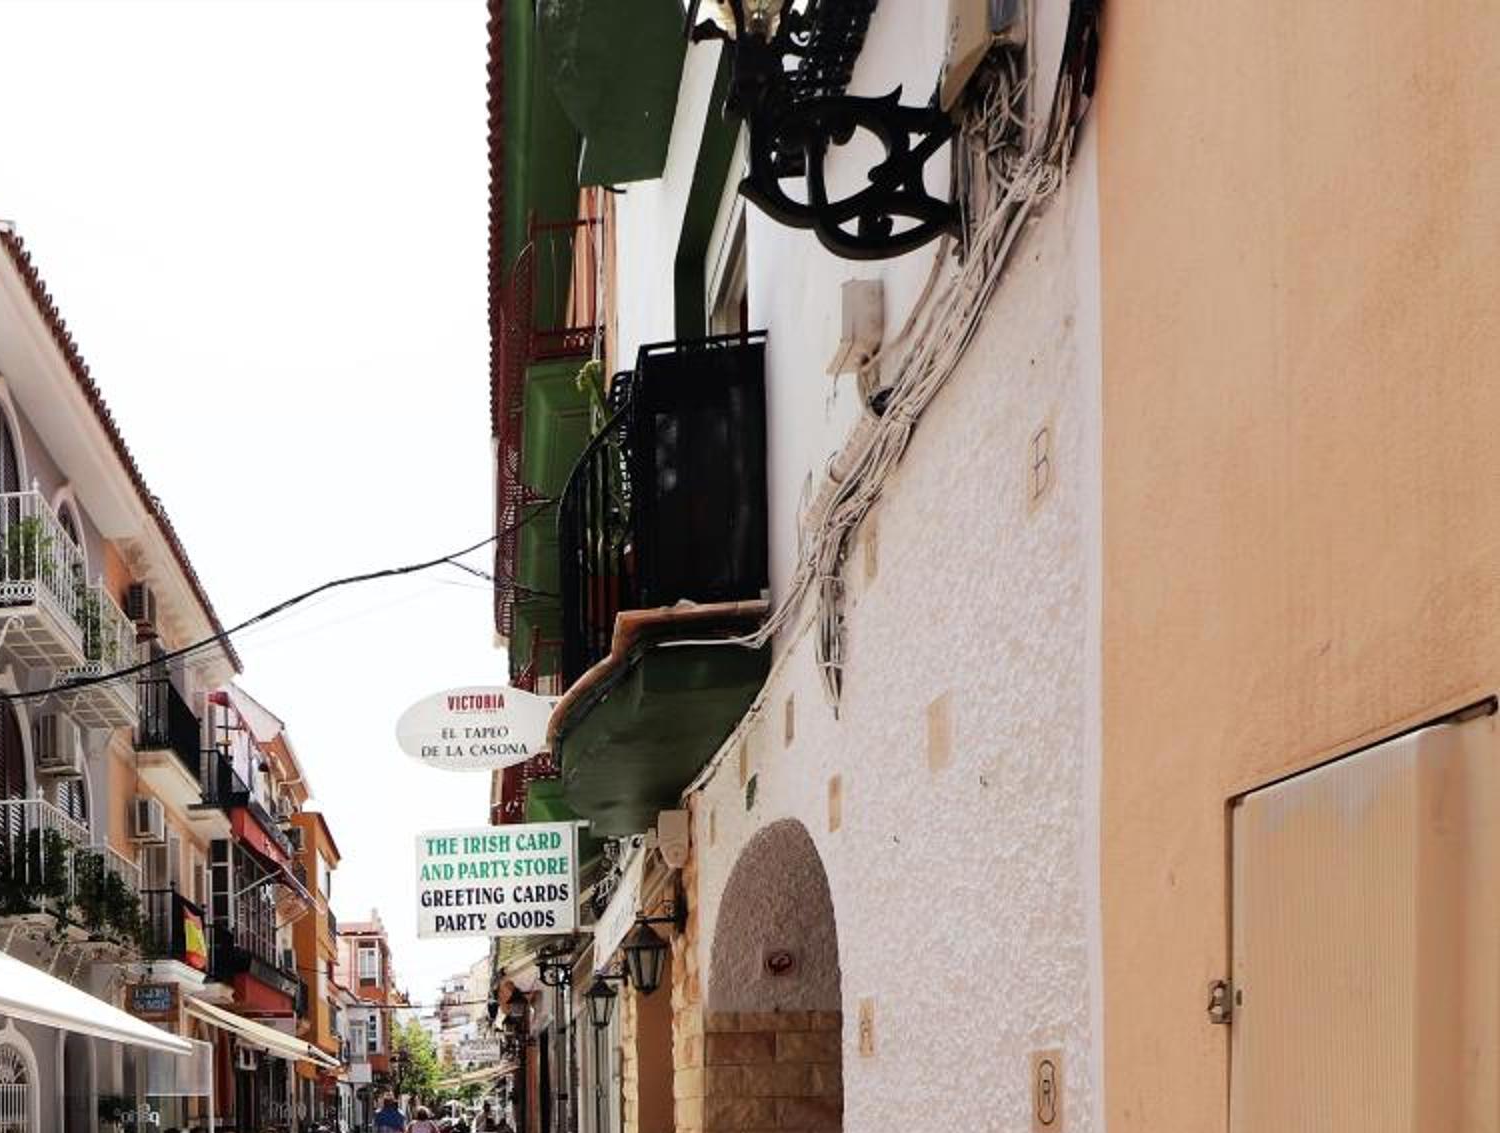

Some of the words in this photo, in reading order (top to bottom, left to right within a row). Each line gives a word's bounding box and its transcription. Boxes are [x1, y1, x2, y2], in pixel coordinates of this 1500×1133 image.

[448, 694, 505, 711] VICTORIA
[442, 728, 457, 739] EL
[422, 746, 439, 757] DE
[446, 745, 463, 757] LA
[470, 743, 528, 756] CASONA
[426, 838, 457, 855] THE
[463, 836, 510, 854] IRISH
[516, 832, 561, 850] CARD
[421, 864, 454, 880] AND
[459, 861, 511, 879] PARTY
[514, 858, 568, 876] STORE
[421, 888, 505, 907] GREETING
[513, 884, 569, 902] CARDS
[436, 914, 487, 932] PARTY
[496, 910, 555, 929] GOODS
